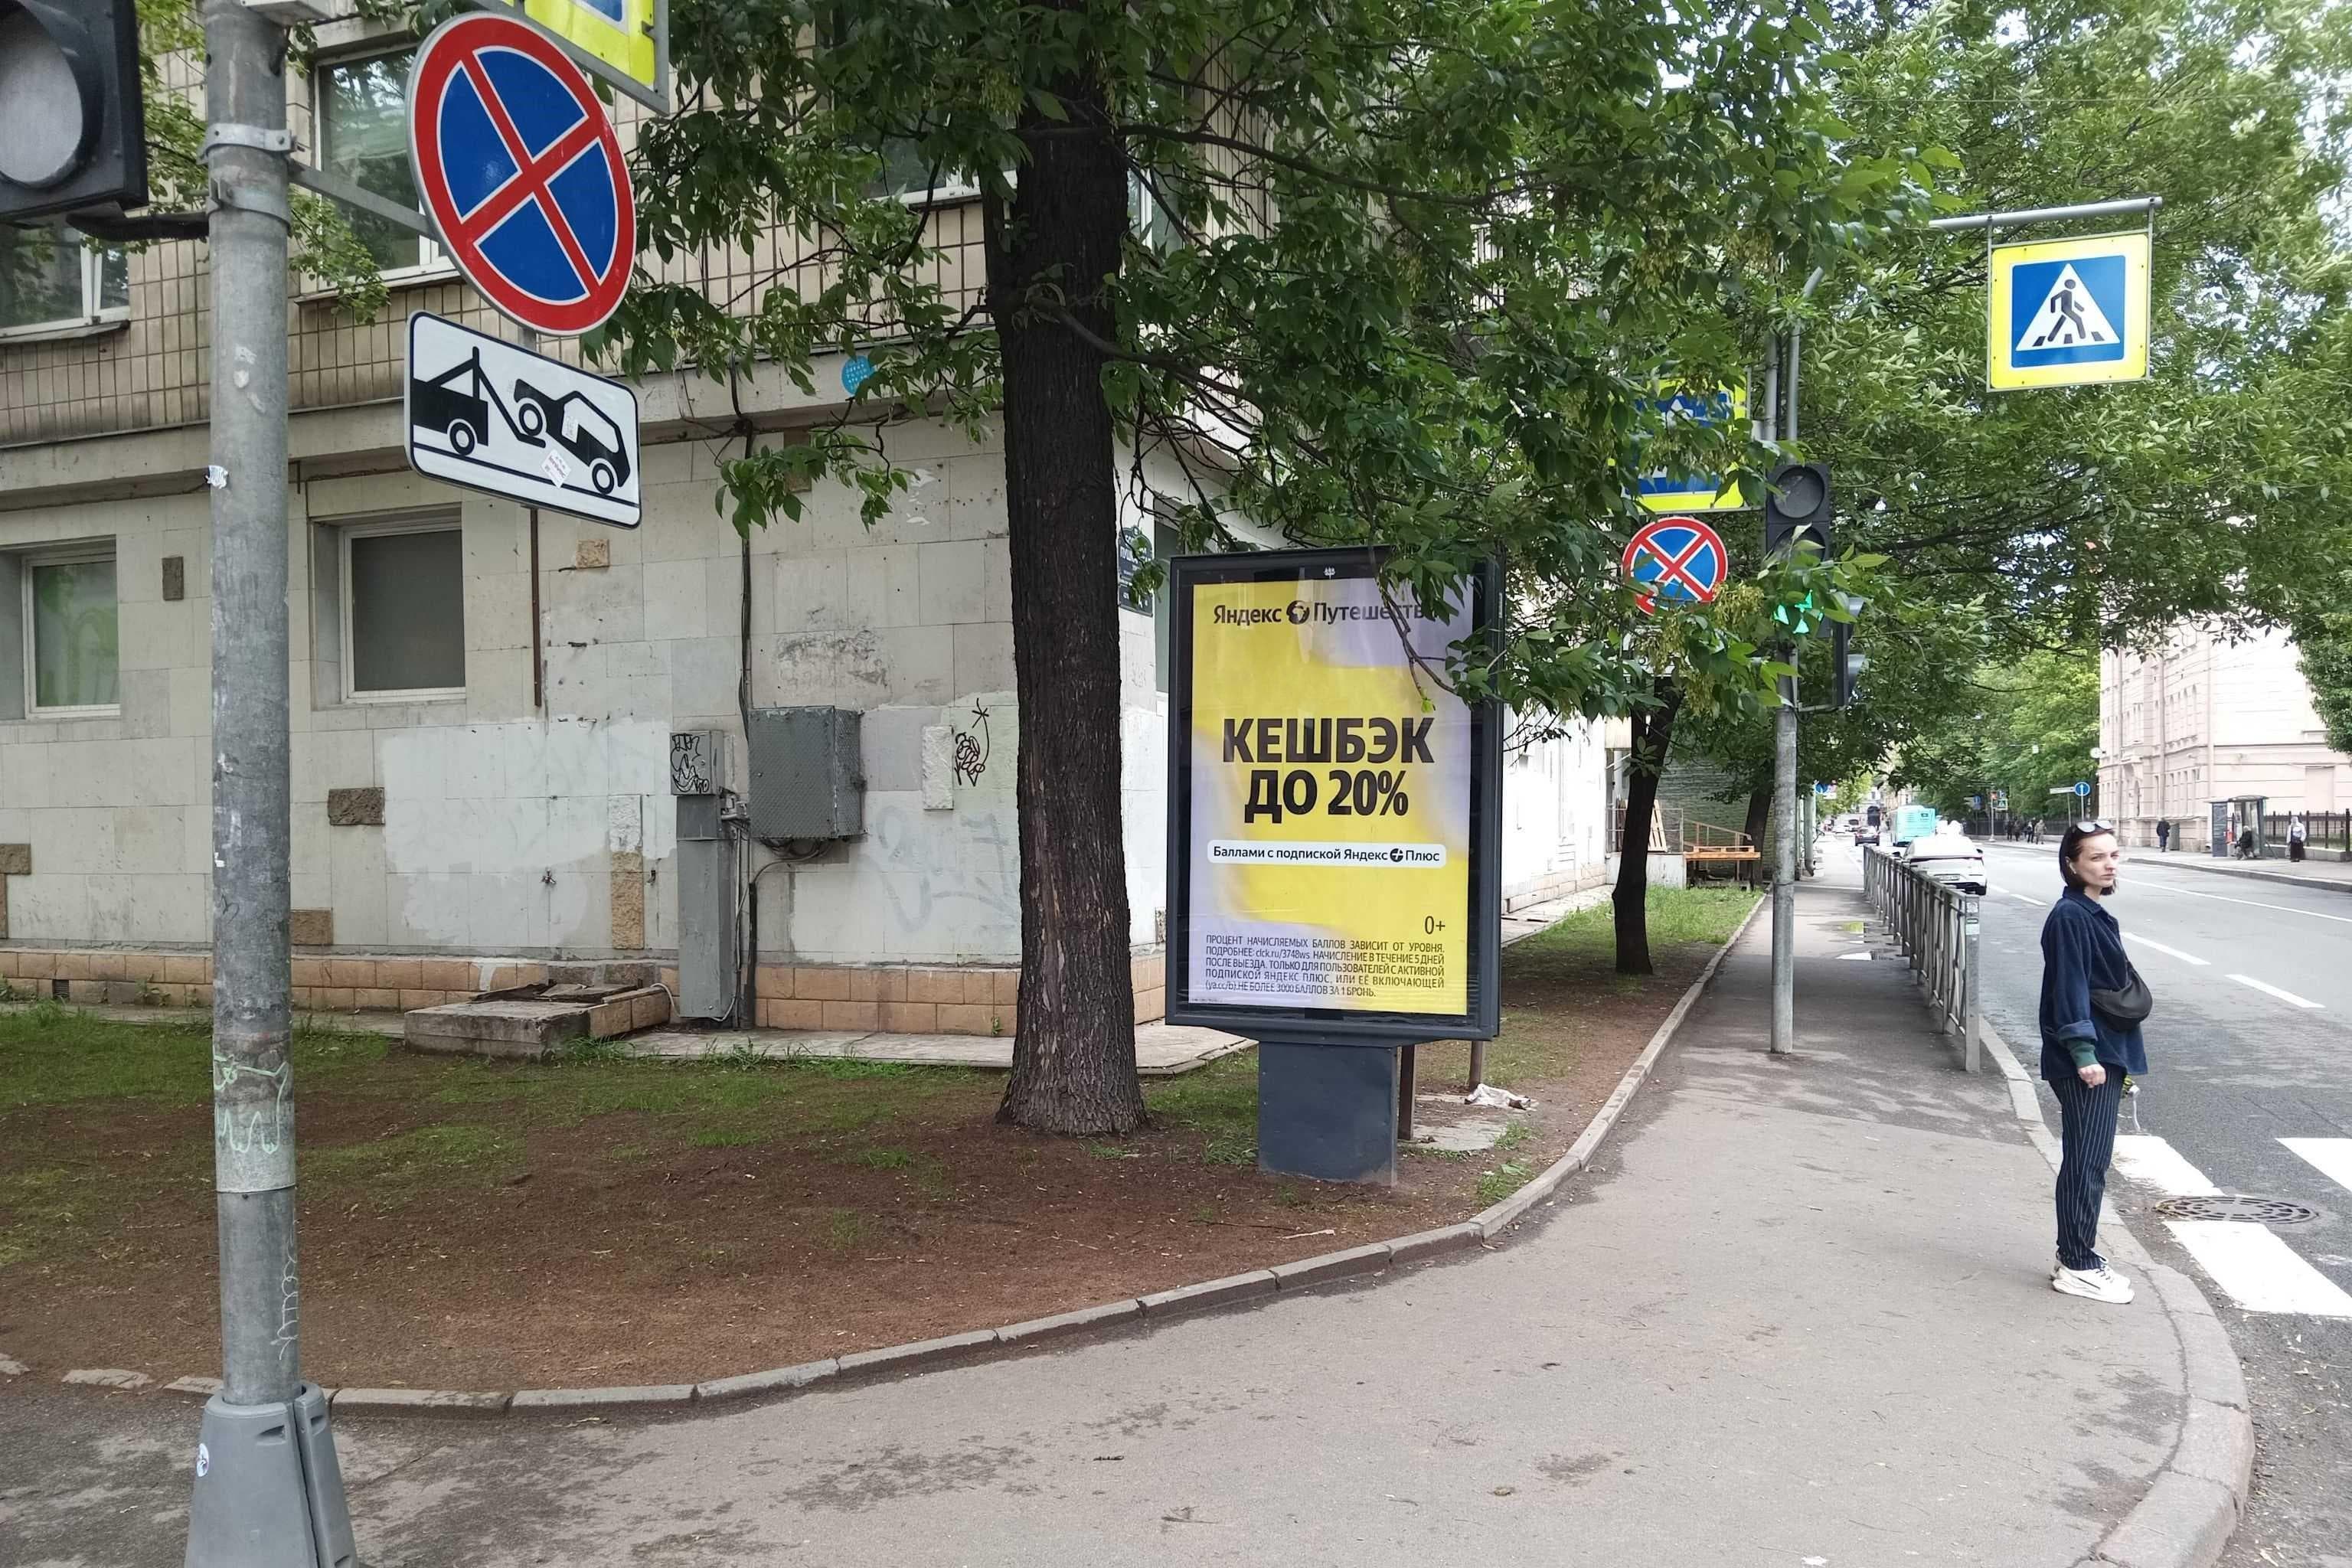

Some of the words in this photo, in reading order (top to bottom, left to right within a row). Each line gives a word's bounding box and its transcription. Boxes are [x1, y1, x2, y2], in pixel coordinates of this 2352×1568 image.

[1214, 605, 1282, 626] Яндекс
[1222, 717, 1436, 764] КЕШБЭК
[1243, 769, 1318, 824] ДО
[1327, 770, 1409, 816] 20%
[1214, 846, 1265, 858] Баллами
[1276, 848, 1341, 860] подпиской
[1344, 849, 1388, 861] Яндекс
[1406, 850, 1440, 861] Плюс
[1424, 916, 1446, 935] 0+
[1206, 935, 1243, 946] ПРОЦЕНТ
[1247, 936, 1308, 948] НАЧИСЛЯЕМЫХ
[1312, 939, 1346, 949] БАЛЛОВ
[1350, 940, 1389, 951] ЗАВИСИТ
[1393, 942, 1405, 952] ОТ
[1409, 942, 1445, 953] УРОВНЯ.
[1206, 957, 1232, 968] ПОСЛЕ
[1269, 960, 1300, 970] ТОЛЬКО
[1302, 962, 1318, 972] ДЛЯ
[1319, 962, 1390, 975] ПОЛЬЗОВАТЕЛЕЙ
[1391, 965, 1396, 975] С
[1397, 965, 1445, 976] АКТИВНОЙ
[1313, 951, 1367, 962] НАЧИСЛЕНИЕ
[1369, 952, 1374, 962] В
[1376, 953, 1413, 963] ТЕЧЕНИЕ
[1414, 954, 1419, 964] 5
[1420, 953, 1445, 965] ДНЕЙ
[1206, 968, 1261, 980] ПОДПИСКОЙ
[1264, 971, 1299, 982] ЯНДЕКС
[1336, 975, 1355, 984] ИЛИ
[1358, 975, 1370, 985] ЕЁ
[1373, 976, 1445, 989] ВКЛЮЧАЮЩЕЙ
[1250, 982, 1275, 992] БОЛЕЕ
[1295, 984, 1328, 995] БАЛЛОВ
[1329, 985, 1340, 995] ЗА
[1347, 986, 1377, 998] БРОНЬ.
